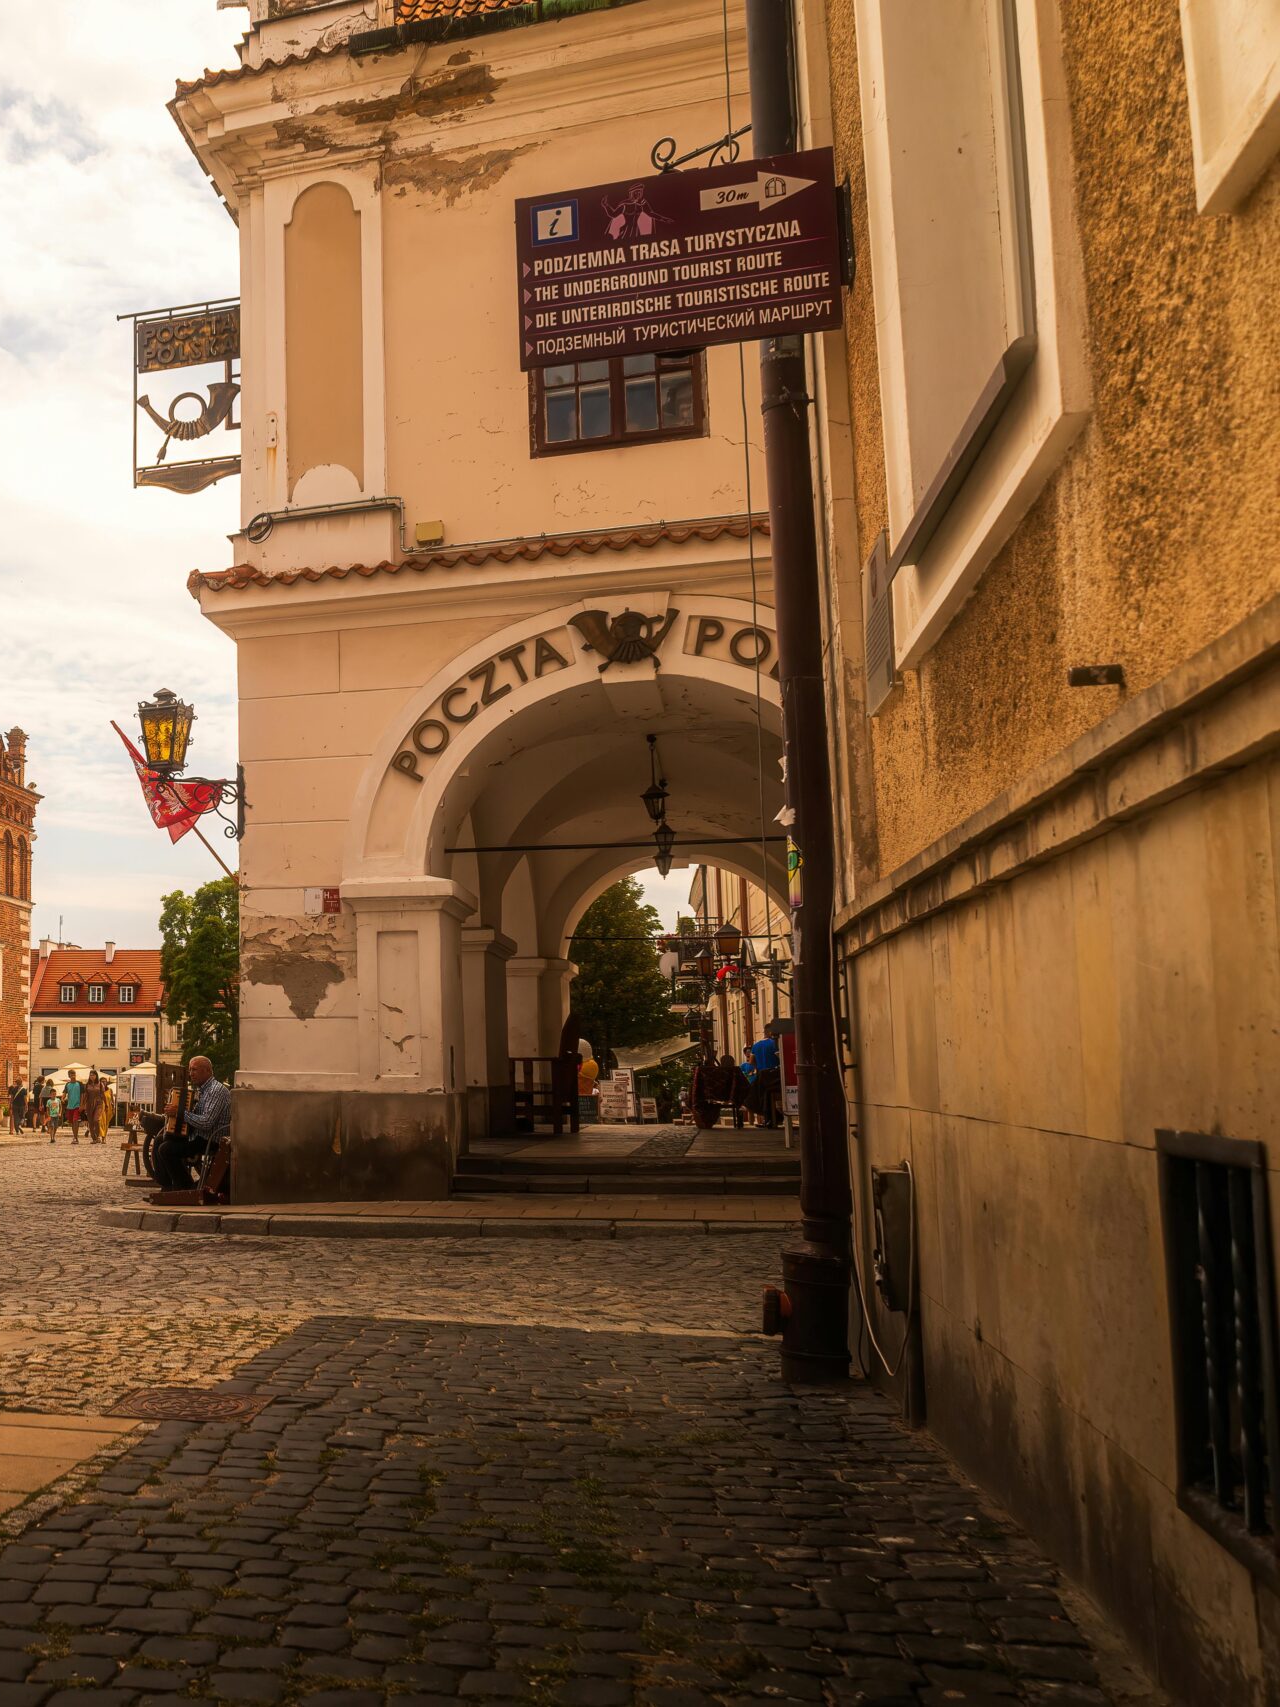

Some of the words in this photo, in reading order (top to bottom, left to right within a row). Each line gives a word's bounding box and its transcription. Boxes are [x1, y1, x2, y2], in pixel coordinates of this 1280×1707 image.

[533, 247, 626, 276] PODZIEMNA
[630, 238, 681, 262] TRASA
[685, 219, 802, 253] TURYSTYCZNA
[534, 285, 559, 302] THE
[563, 269, 669, 298] UNDERGROUND
[672, 259, 732, 282] TOURIST
[736, 251, 782, 272] ROUTE
[535, 312, 558, 329] DIE
[561, 295, 672, 325] UNTERIRDISCHE
[676, 282, 779, 309] TOURISTISCHE
[783, 271, 830, 295] ROUTE
[143, 313, 238, 348] POCZTA
[143, 338, 234, 368] POLSKA
[536, 327, 626, 356] ПОДЗЕМНЫЙ
[633, 307, 755, 343] ТУРИСТИЧЕСКИЙ
[758, 299, 833, 325] МАРШРУТ
[694, 617, 780, 680] PO
[391, 636, 569, 783] POCZTA
